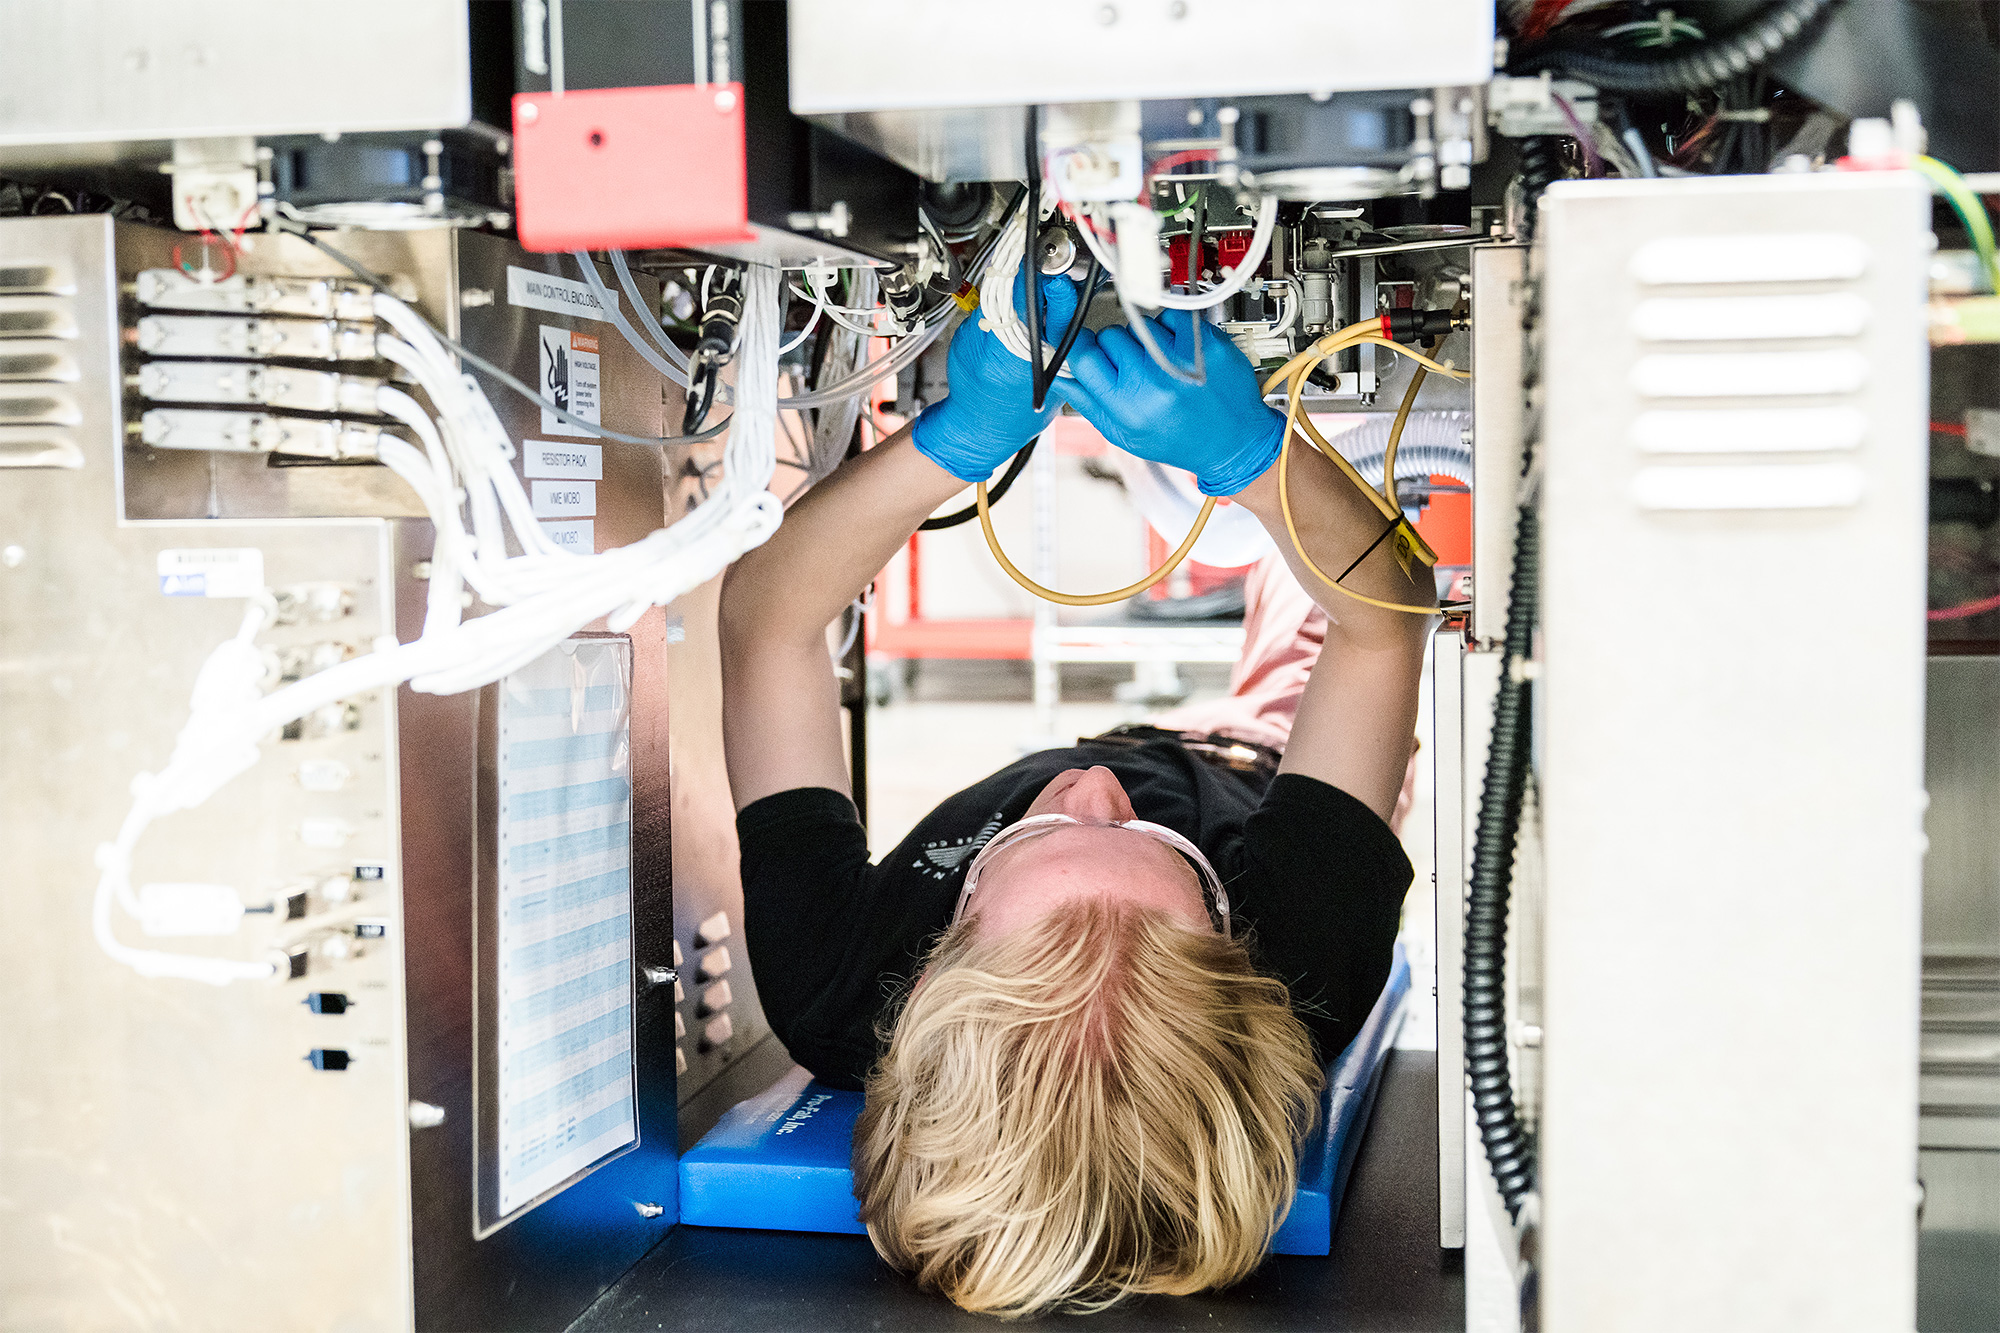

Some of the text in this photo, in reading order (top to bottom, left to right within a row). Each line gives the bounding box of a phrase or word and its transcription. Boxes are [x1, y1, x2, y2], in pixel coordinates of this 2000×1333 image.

[526, 281, 541, 297] MAIN
[543, 284, 571, 303] CONTROL
[577, 336, 599, 351] WARNING
[542, 452, 587, 467] RESISTOR PACK
[564, 491, 580, 504] MOBO
[562, 531, 578, 544] MOBO
[786, 1094, 833, 1121] Pro-Fab,
[776, 1121, 805, 1135] Inc.
